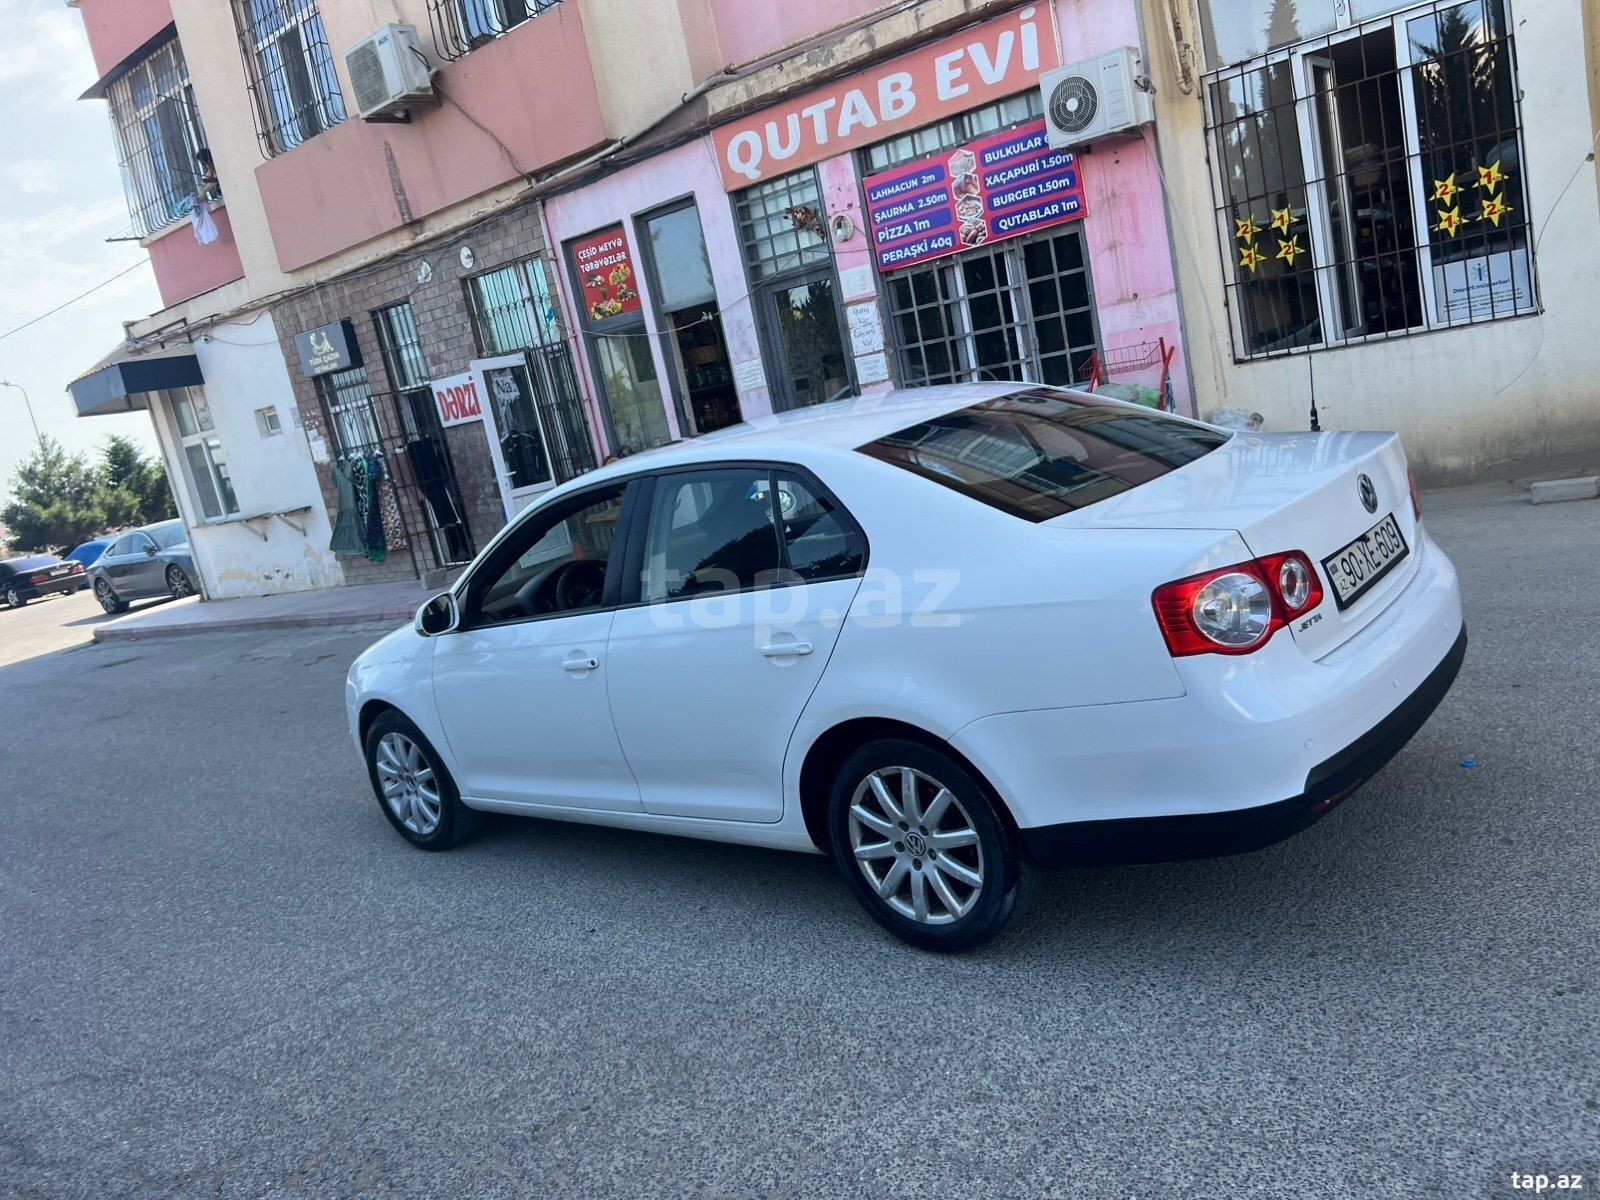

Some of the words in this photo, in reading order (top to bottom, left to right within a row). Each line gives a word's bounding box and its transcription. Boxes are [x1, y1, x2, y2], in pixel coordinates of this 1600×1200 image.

[727, 72, 917, 180] QUTAB
[934, 7, 1039, 101] EVİ
[984, 137, 1041, 163] BULKULAR
[985, 159, 1039, 187] XAÇAPURİ
[1041, 153, 1073, 169] 1.50m
[1483, 171, 1492, 184] 1
[871, 178, 918, 200] LAHMACUN
[921, 174, 935, 184] 2m
[992, 186, 1036, 207] BURGER
[1038, 178, 1069, 193] 1.50m
[1439, 183, 1449, 196] 2
[874, 203, 914, 223] ŞAURMA
[917, 193, 947, 208] 2.50m
[999, 204, 1059, 230] QUTABLAR
[1061, 200, 1077, 211] 1m
[1486, 203, 1498, 216] 2
[1241, 224, 1250, 234] 2
[1277, 214, 1285, 226] 1
[1444, 215, 1453, 228] 1
[878, 223, 912, 242] PİZZA
[914, 220, 930, 231] 1m
[578, 245, 597, 262] ÇEŞİD
[599, 238, 622, 253] MEYVƏ
[882, 239, 928, 263] PERAŞKİ
[930, 236, 953, 249] 40q
[1245, 252, 1252, 264] 1
[1283, 244, 1292, 255] 2
[580, 252, 627, 273] TƏRƏVƏZLƏR
[436, 375, 481, 422] DƏRZİ
[1339, 578, 1349, 592] AZ
[1299, 612, 1322, 632] JETTA
